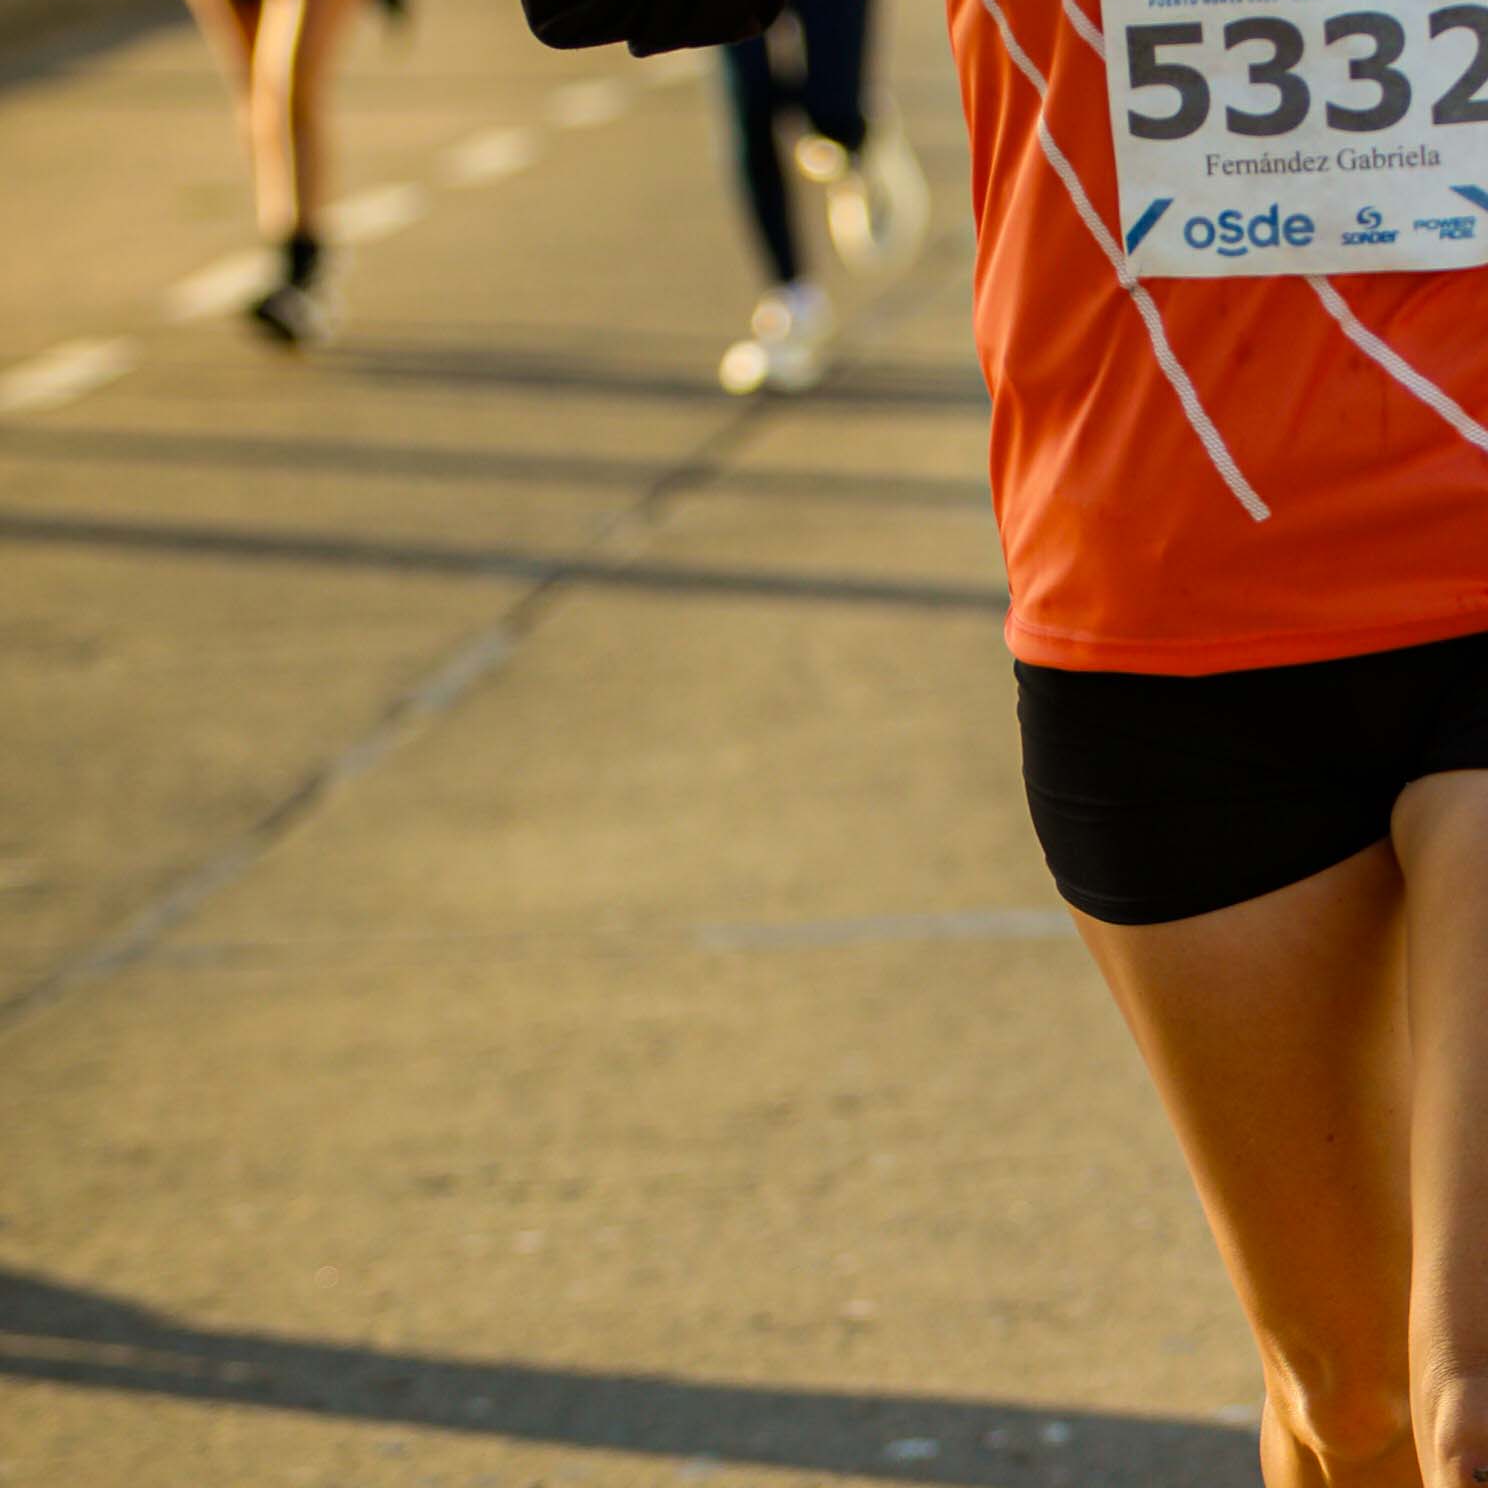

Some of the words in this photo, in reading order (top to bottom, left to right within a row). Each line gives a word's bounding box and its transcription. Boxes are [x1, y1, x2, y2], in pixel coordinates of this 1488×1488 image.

[1205, 150, 1330, 177] Fernández
[1336, 144, 1442, 172] Gabriela
[1183, 203, 1316, 252] osde
